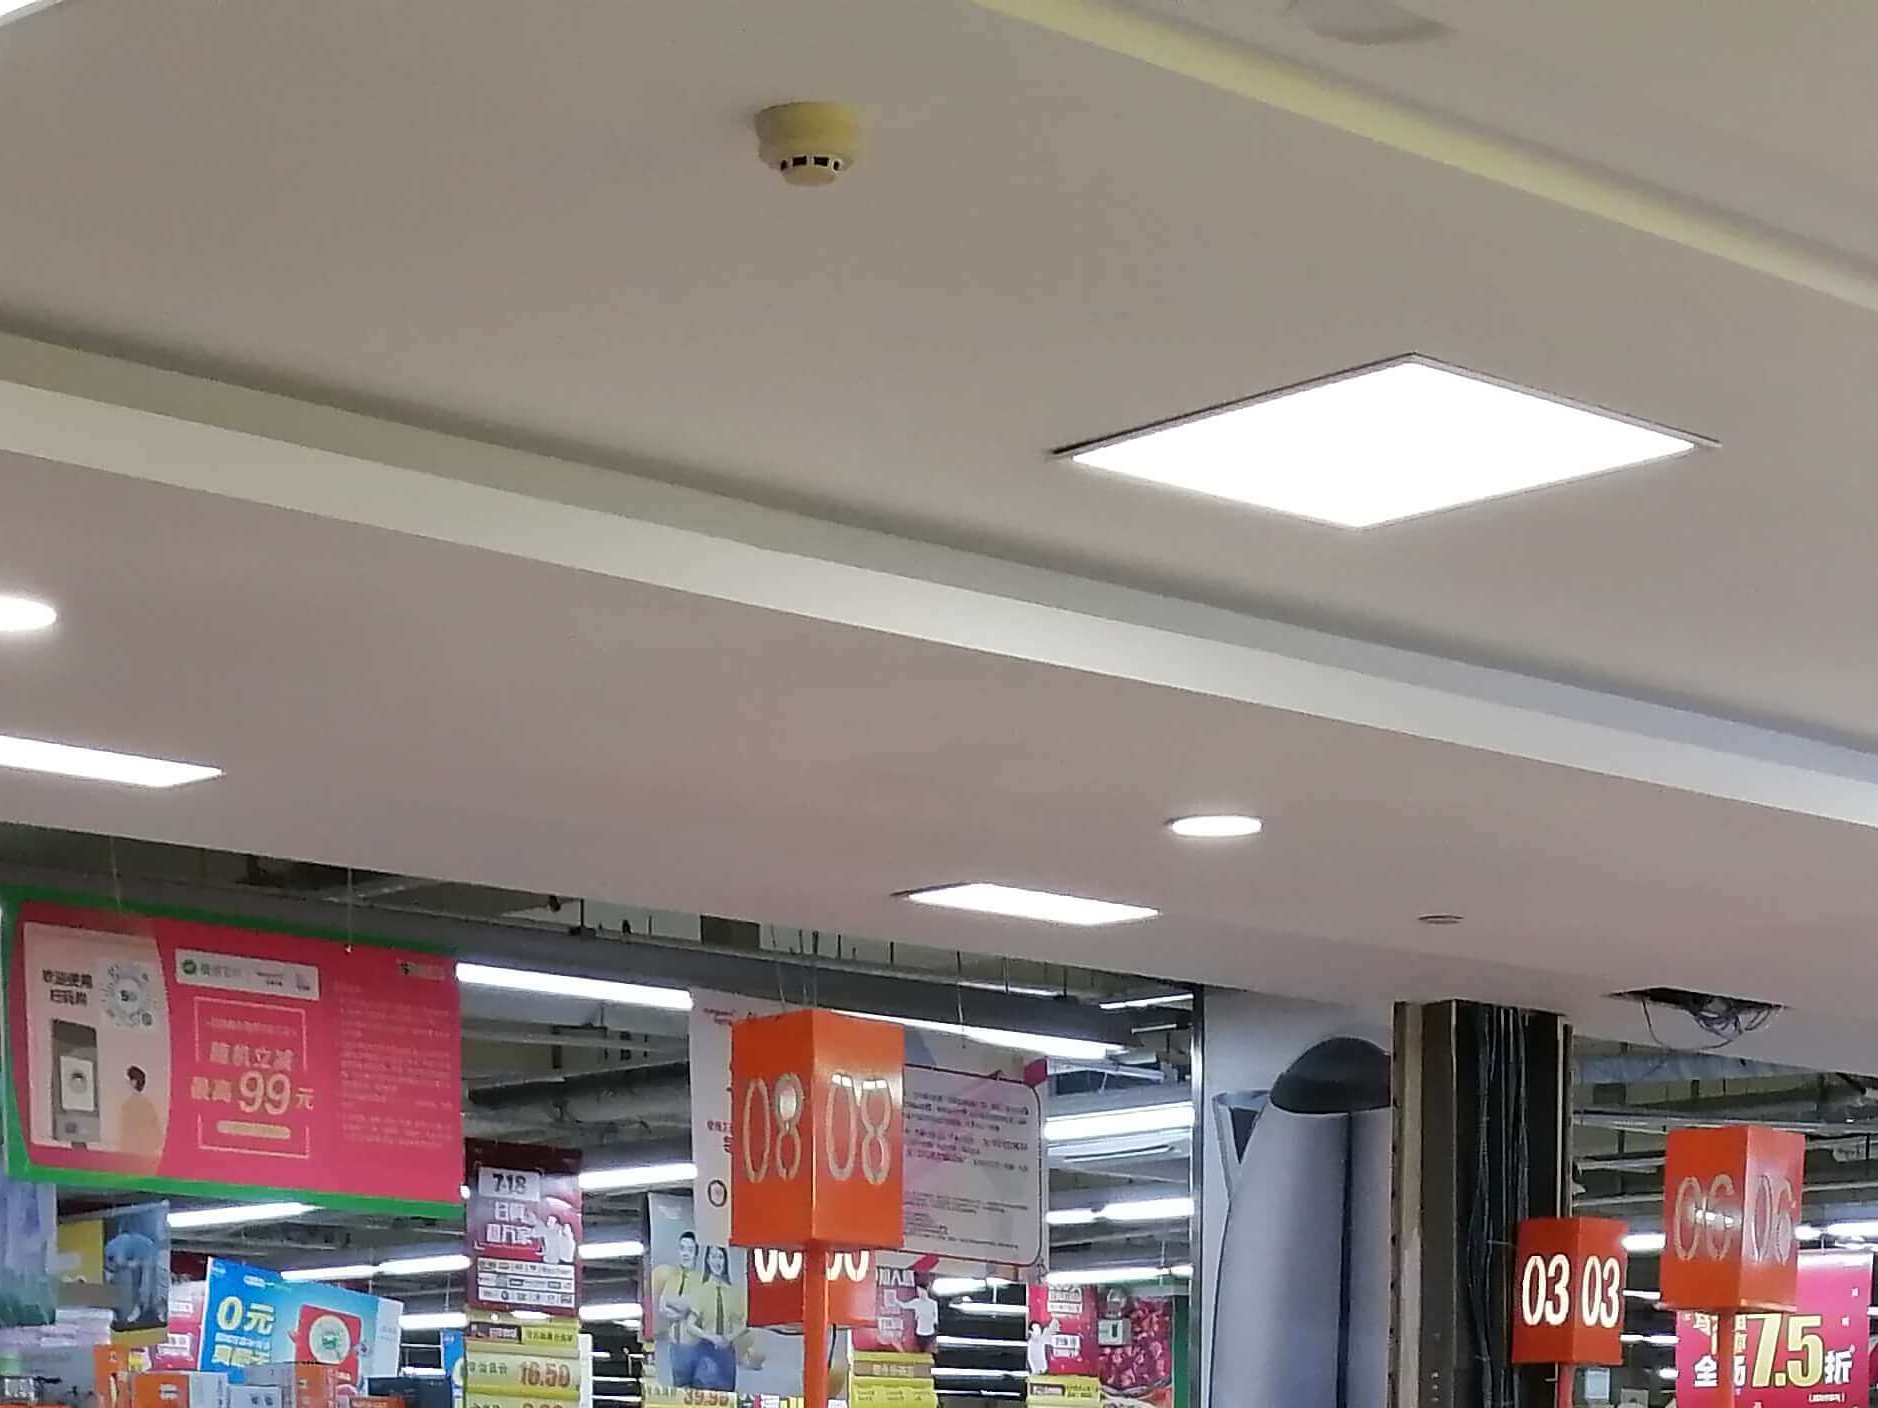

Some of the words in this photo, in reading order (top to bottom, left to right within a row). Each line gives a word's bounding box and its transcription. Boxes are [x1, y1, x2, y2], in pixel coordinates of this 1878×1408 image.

[743, 1072, 804, 1185] 08
[826, 1069, 893, 1186] 08
[1522, 1254, 1570, 1326] 03
[1581, 1255, 1620, 1328] 03
[521, 1361, 570, 1388] 16.50
